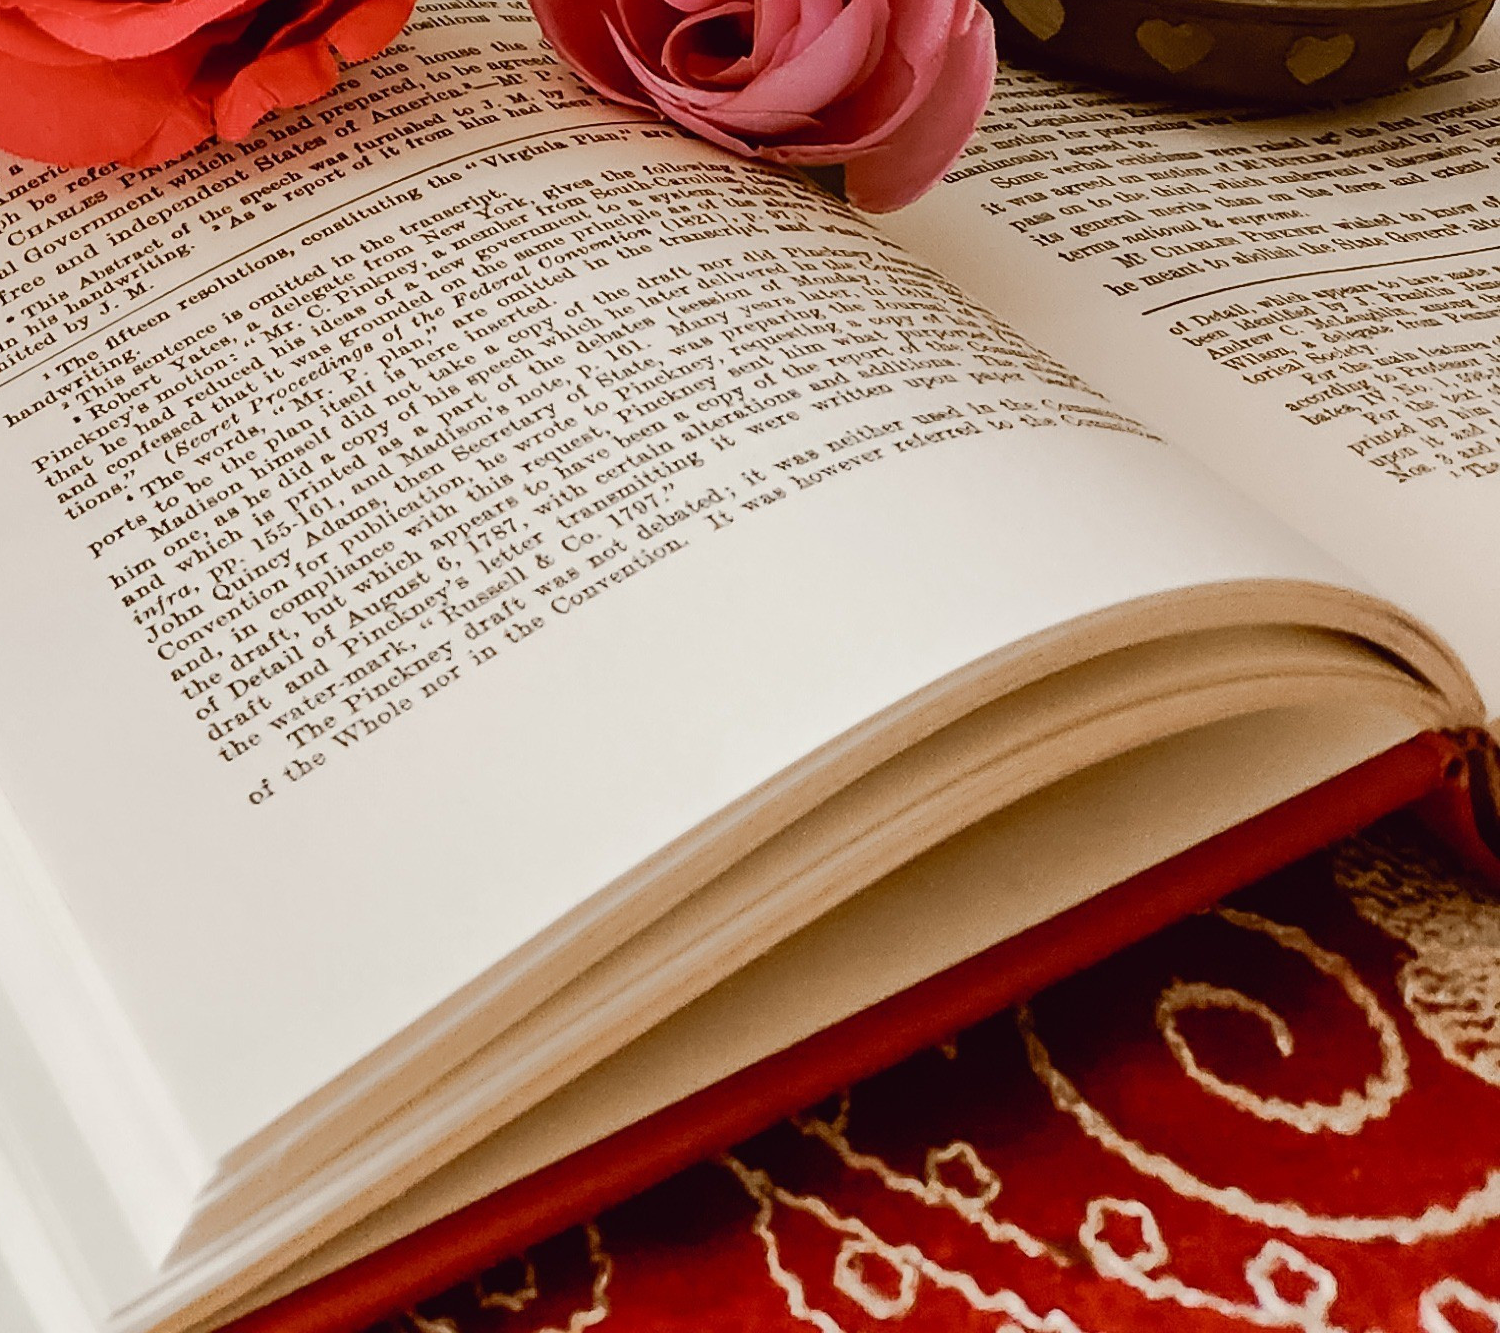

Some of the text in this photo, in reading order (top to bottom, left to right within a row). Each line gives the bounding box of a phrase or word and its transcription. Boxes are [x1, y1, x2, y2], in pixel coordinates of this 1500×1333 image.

[8, 163, 24, 176] a
[23, 186, 164, 263] Government
[166, 144, 236, 188] which
[233, 138, 267, 156] he
[265, 112, 316, 142] had
[316, 77, 425, 124] prepared,
[425, 70, 451, 83] to
[450, 64, 482, 76] be
[486, 53, 559, 77] agreed
[989, 157, 1113, 189] Some verbal
[7, 190, 108, 246] CHARLES
[20, 88, 564, 318] This Abstract of the speech was furnished to J. M. by
[23, 314, 58, 336] his
[63, 244, 194, 314] handwriting.
[229, 210, 255, 229] As
[261, 201, 277, 212] a
[282, 168, 346, 201] report
[351, 154, 373, 170] of
[377, 145, 400, 159] it
[404, 127, 454, 149] from
[456, 114, 501, 130] him
[501, 102, 543, 118] had
[544, 93, 593, 110] been
[27, 192, 57, 212] be
[55, 243, 99, 275] and
[106, 169, 249, 246] independent
[253, 135, 327, 172] States
[333, 119, 361, 138] of
[980, 175, 1116, 216] it was agreed
[1008, 211, 1056, 233] pass
[1058, 204, 1085, 215] on
[1086, 197, 1112, 208] to
[1112, 190, 1149, 203] the
[1398, 207, 1427, 224] to
[1028, 201, 1211, 247] its general merits
[1057, 209, 1309, 262] terms national supreme.
[54, 171, 462, 376] The fifteen resolutions, constituting the
[74, 189, 507, 405] This sentence is omitted in the transcript.
[1102, 244, 1302, 296] he meant to abolish
[62, 314, 88, 333] by
[98, 299, 119, 315] J.
[122, 280, 154, 300] M.
[1206, 332, 1277, 360] Andrew
[1242, 357, 1309, 384] torical
[3, 349, 140, 427] handwriting.
[87, 296, 556, 558] ports to be the plan itself is here inserted.
[145, 336, 713, 643] John Quincy Adams, then Secretary of State, was
[285, 404, 964, 748] The Pinckney draft was not debated; it was neither used
[248, 419, 1013, 805] of the Whole nor in the Convention. It was however referred to
[218, 733, 259, 762] the
[269, 641, 416, 729] water-mark,
[439, 566, 527, 624] Russell
[534, 553, 555, 569] &
[560, 532, 602, 552] Co.
